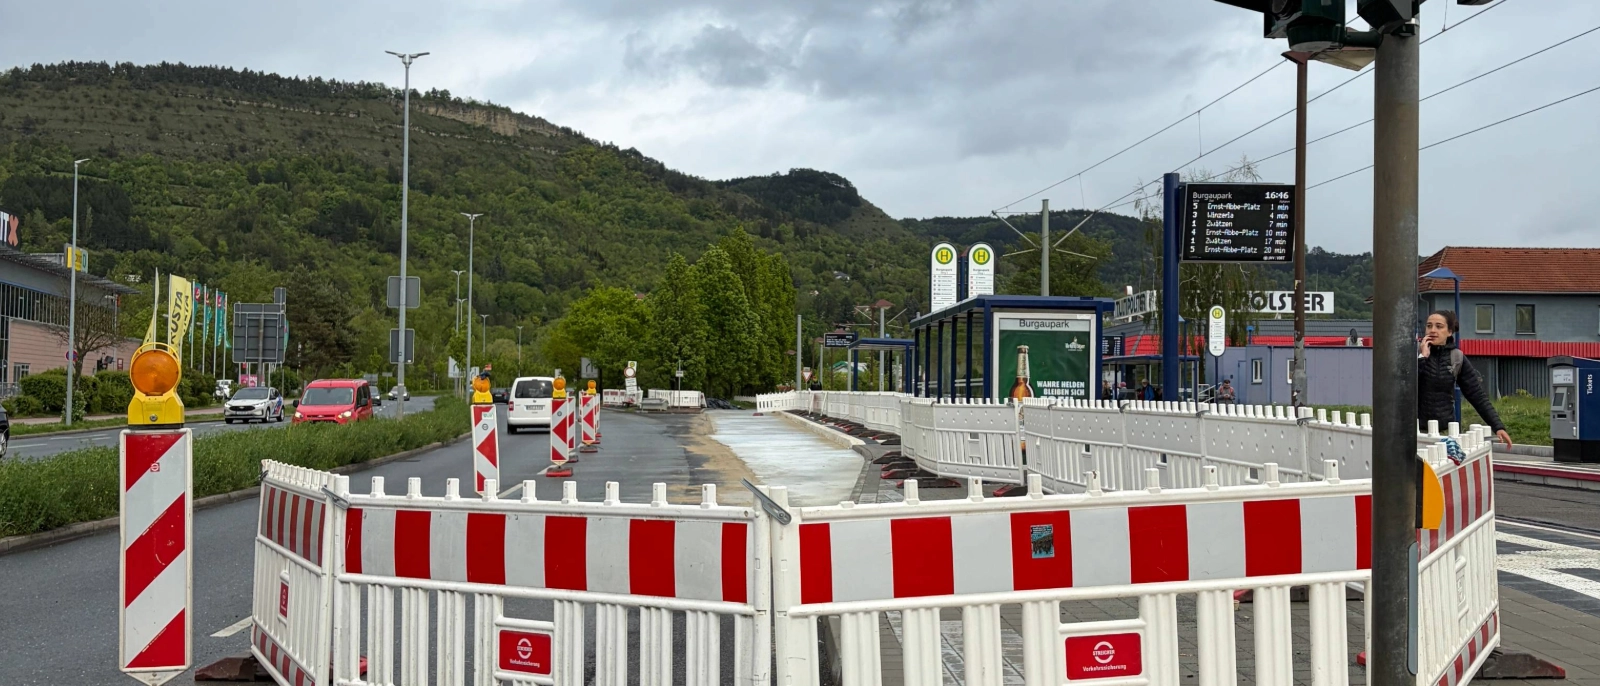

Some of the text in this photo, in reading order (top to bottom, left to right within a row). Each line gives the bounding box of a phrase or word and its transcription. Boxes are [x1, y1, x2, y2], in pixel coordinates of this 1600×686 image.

[1192, 192, 1232, 200] Burgaupark
[940, 250, 948, 260] H
[978, 251, 986, 261] H
[1019, 319, 1070, 329] Burgaupark
